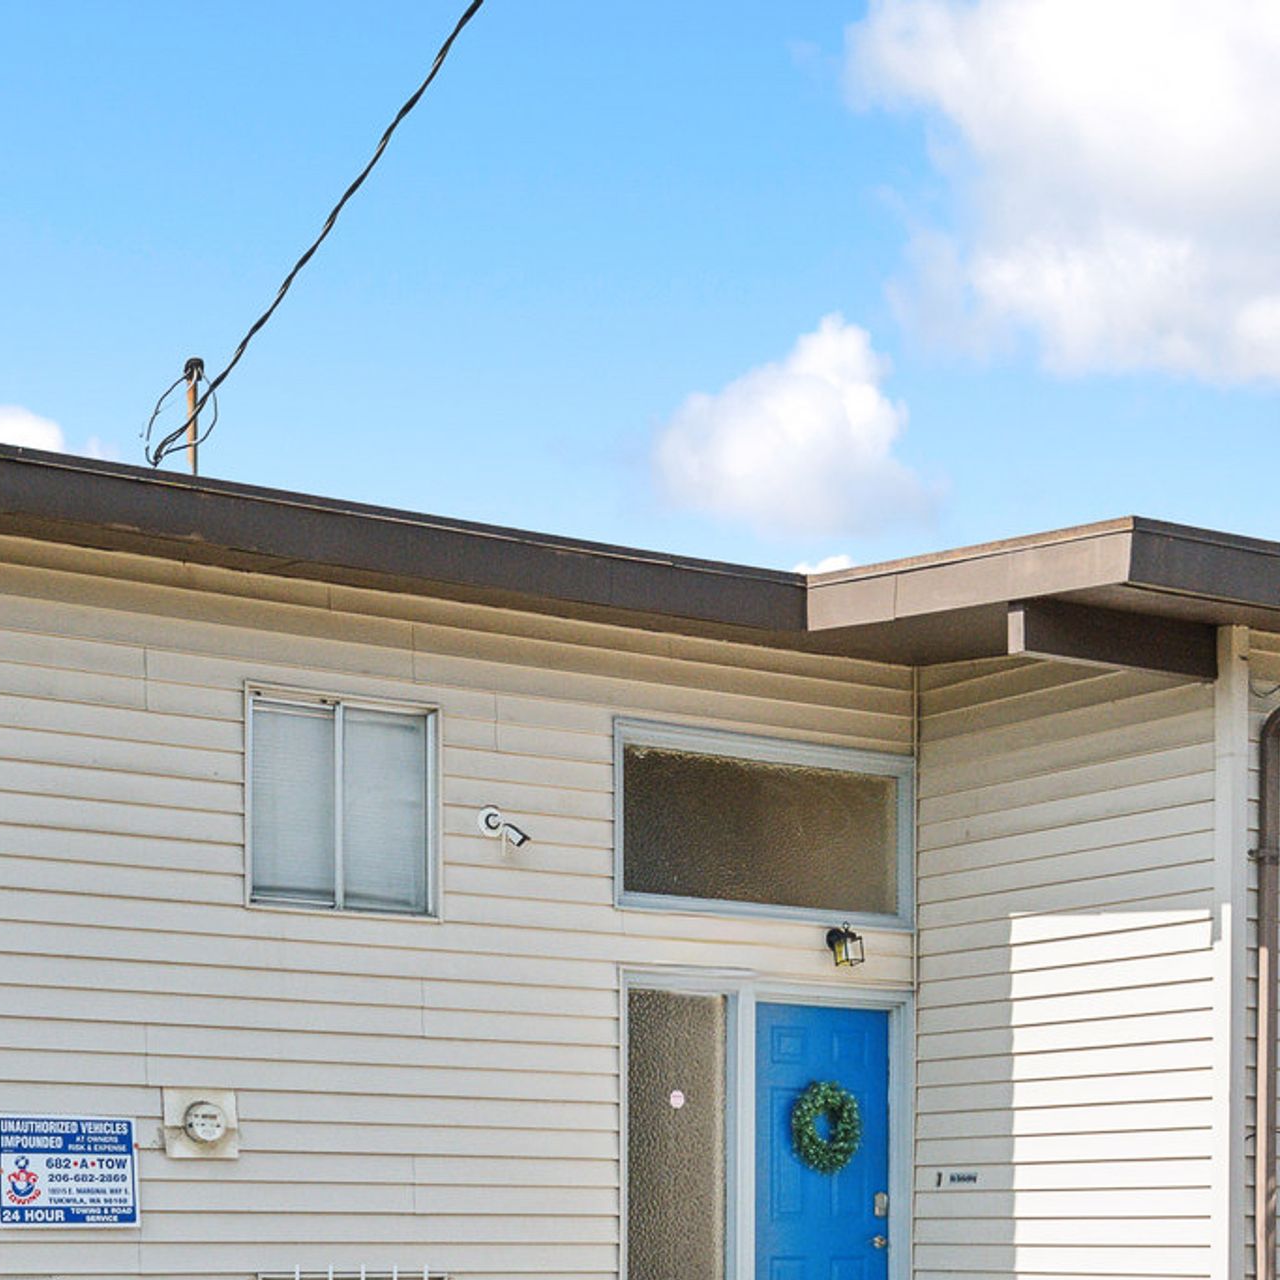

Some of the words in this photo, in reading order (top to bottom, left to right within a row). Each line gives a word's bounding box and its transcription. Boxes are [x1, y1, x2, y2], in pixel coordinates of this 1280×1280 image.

[0, 1119, 79, 1134] UNAUTHORIZED
[80, 1121, 129, 1135] VEHICLES
[0, 1135, 63, 1149] IMPOUNDED
[2, 1209, 21, 1222] 24
[24, 1209, 66, 1222] HOUR
